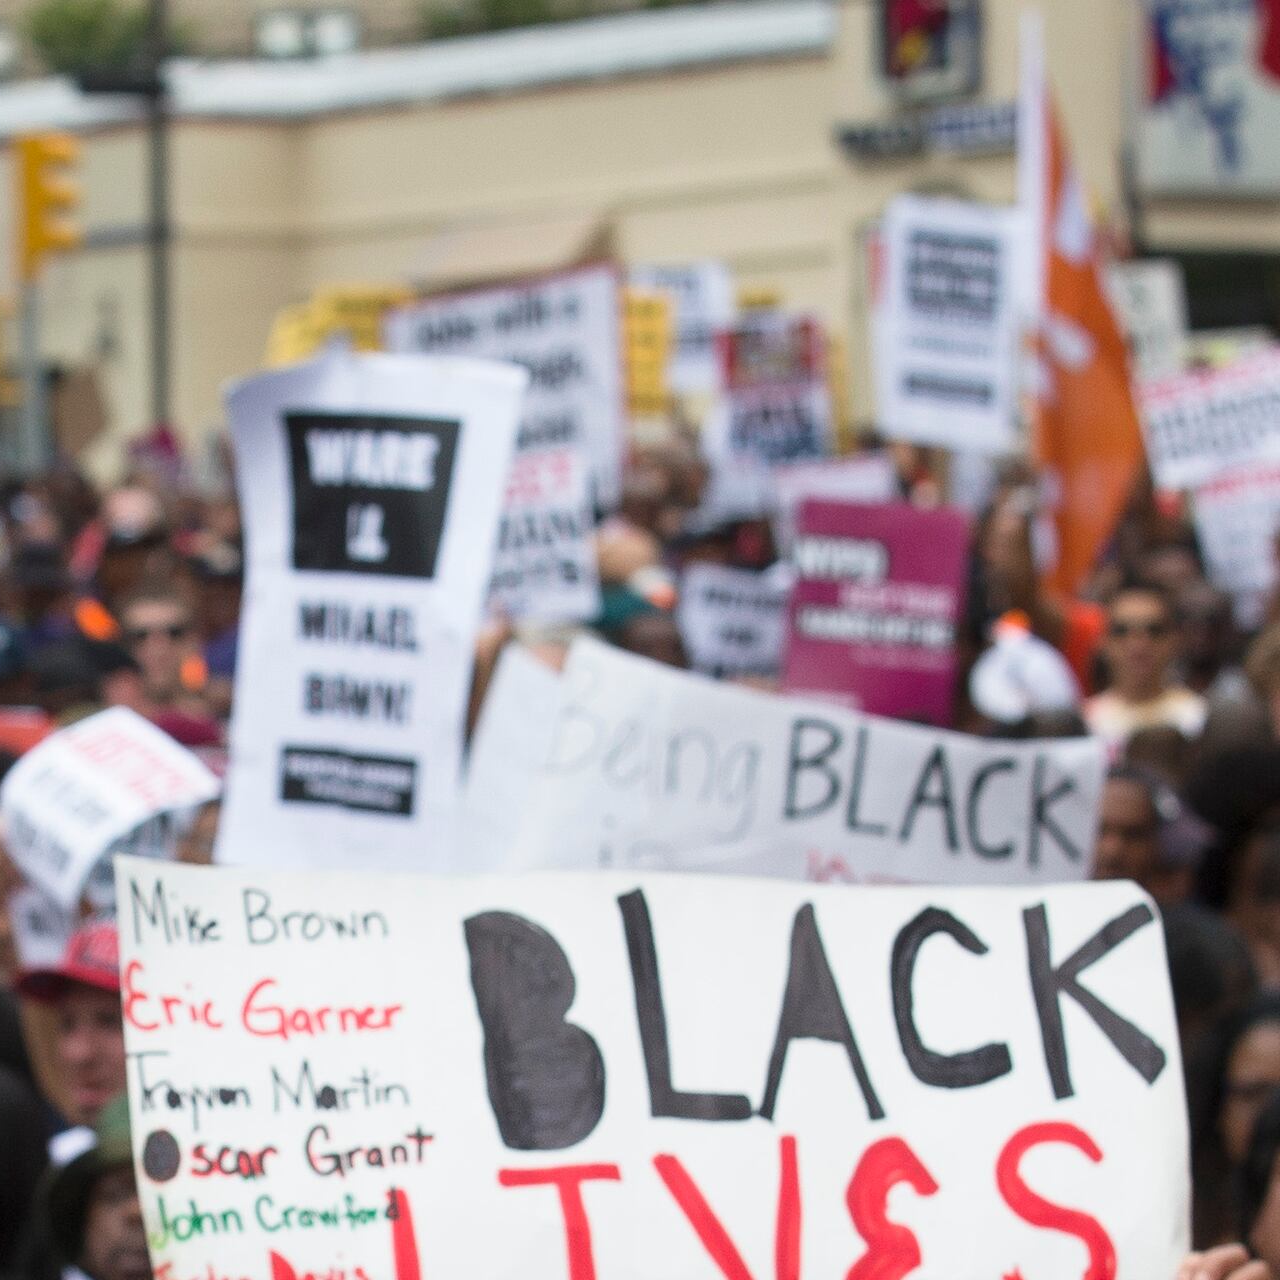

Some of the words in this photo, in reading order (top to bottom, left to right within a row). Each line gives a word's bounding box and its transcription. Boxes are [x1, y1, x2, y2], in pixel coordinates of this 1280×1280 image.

[782, 716, 1083, 868] BLACK
[129, 878, 221, 947] Mike
[242, 887, 389, 946] Brown
[122, 959, 223, 1031] Eric
[241, 977, 403, 1040] Garner
[463, 886, 1168, 1152] BLACK
[271, 1059, 411, 1112] Martin
[142, 1129, 278, 1183] Oscar
[305, 1124, 435, 1179] Grant
[151, 1193, 243, 1249] John
